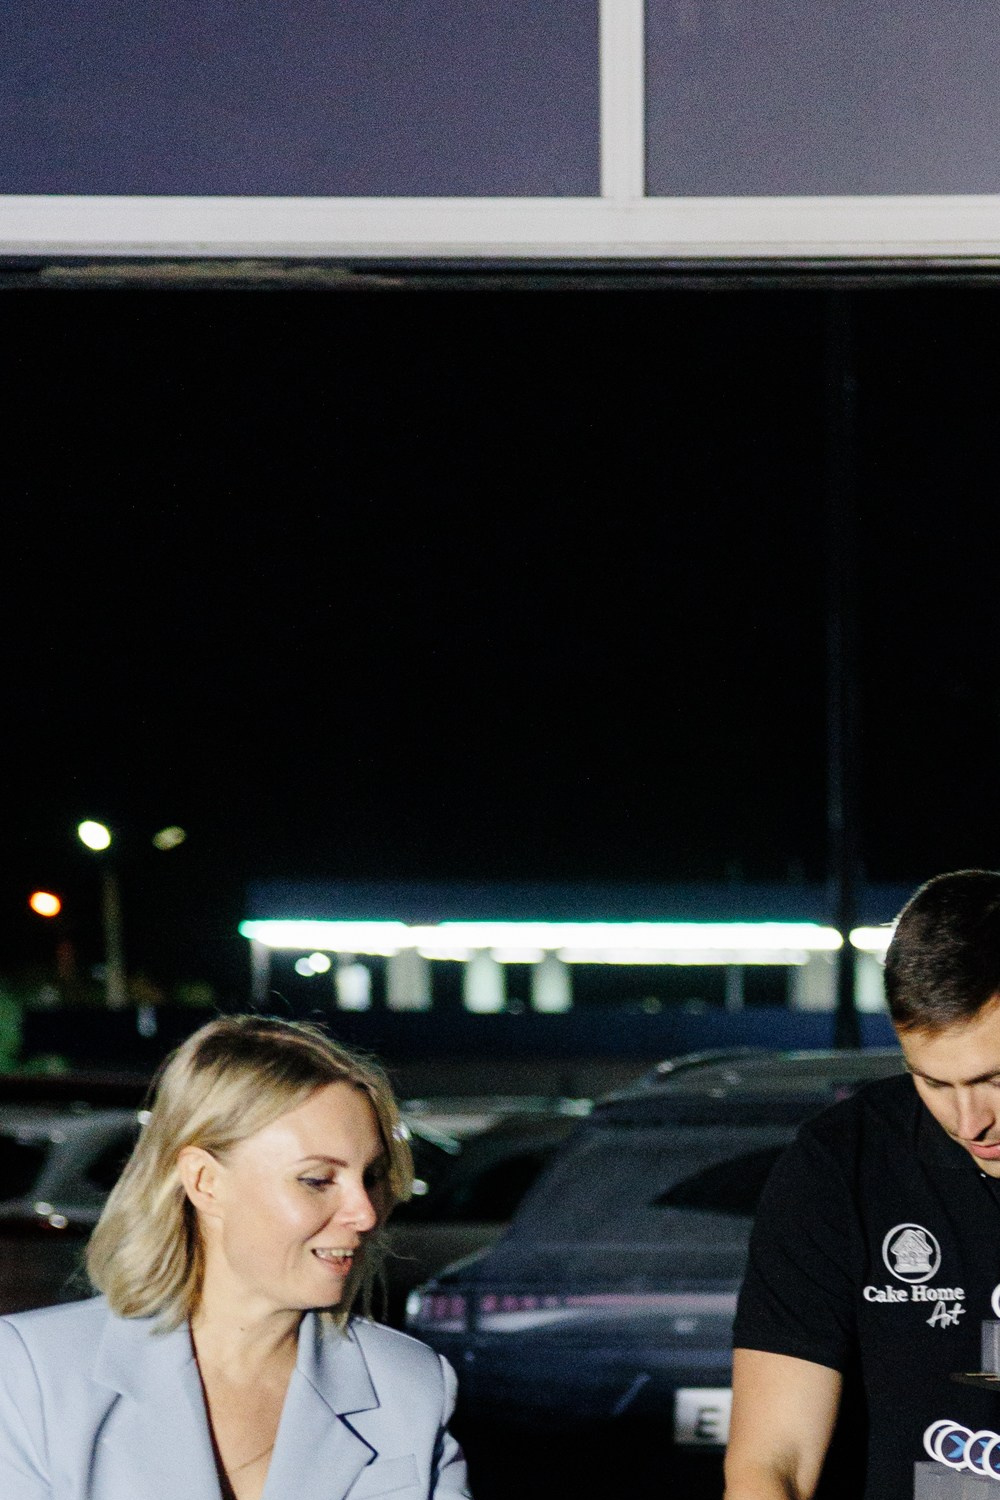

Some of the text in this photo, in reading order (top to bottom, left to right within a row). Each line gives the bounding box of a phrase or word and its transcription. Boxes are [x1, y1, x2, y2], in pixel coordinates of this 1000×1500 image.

[862, 1284, 966, 1303] Cake Home
[926, 1301, 967, 1329] Art
